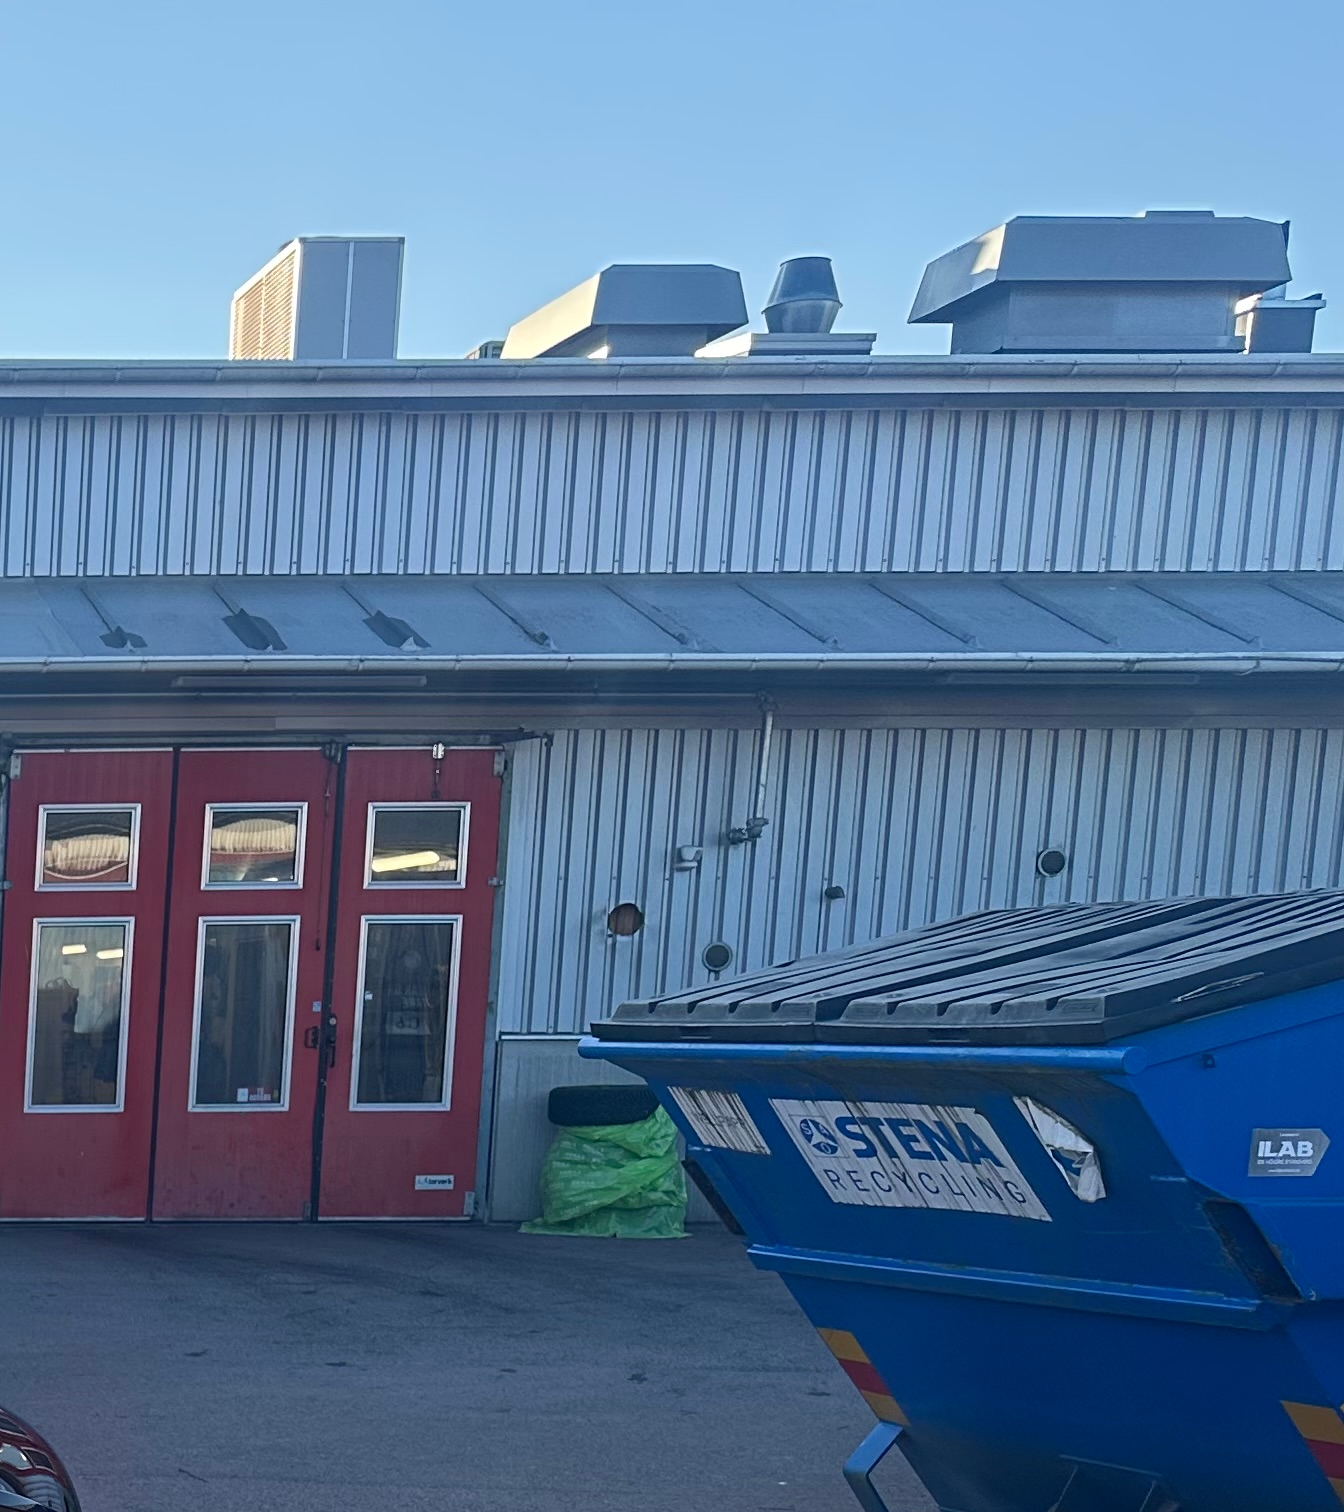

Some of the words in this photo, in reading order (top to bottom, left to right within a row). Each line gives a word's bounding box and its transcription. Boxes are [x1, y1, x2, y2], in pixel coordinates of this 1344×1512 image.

[834, 1116, 1006, 1168] STENA
[1257, 1141, 1314, 1157] ILAB
[824, 1169, 1027, 1204] RECYCLING
